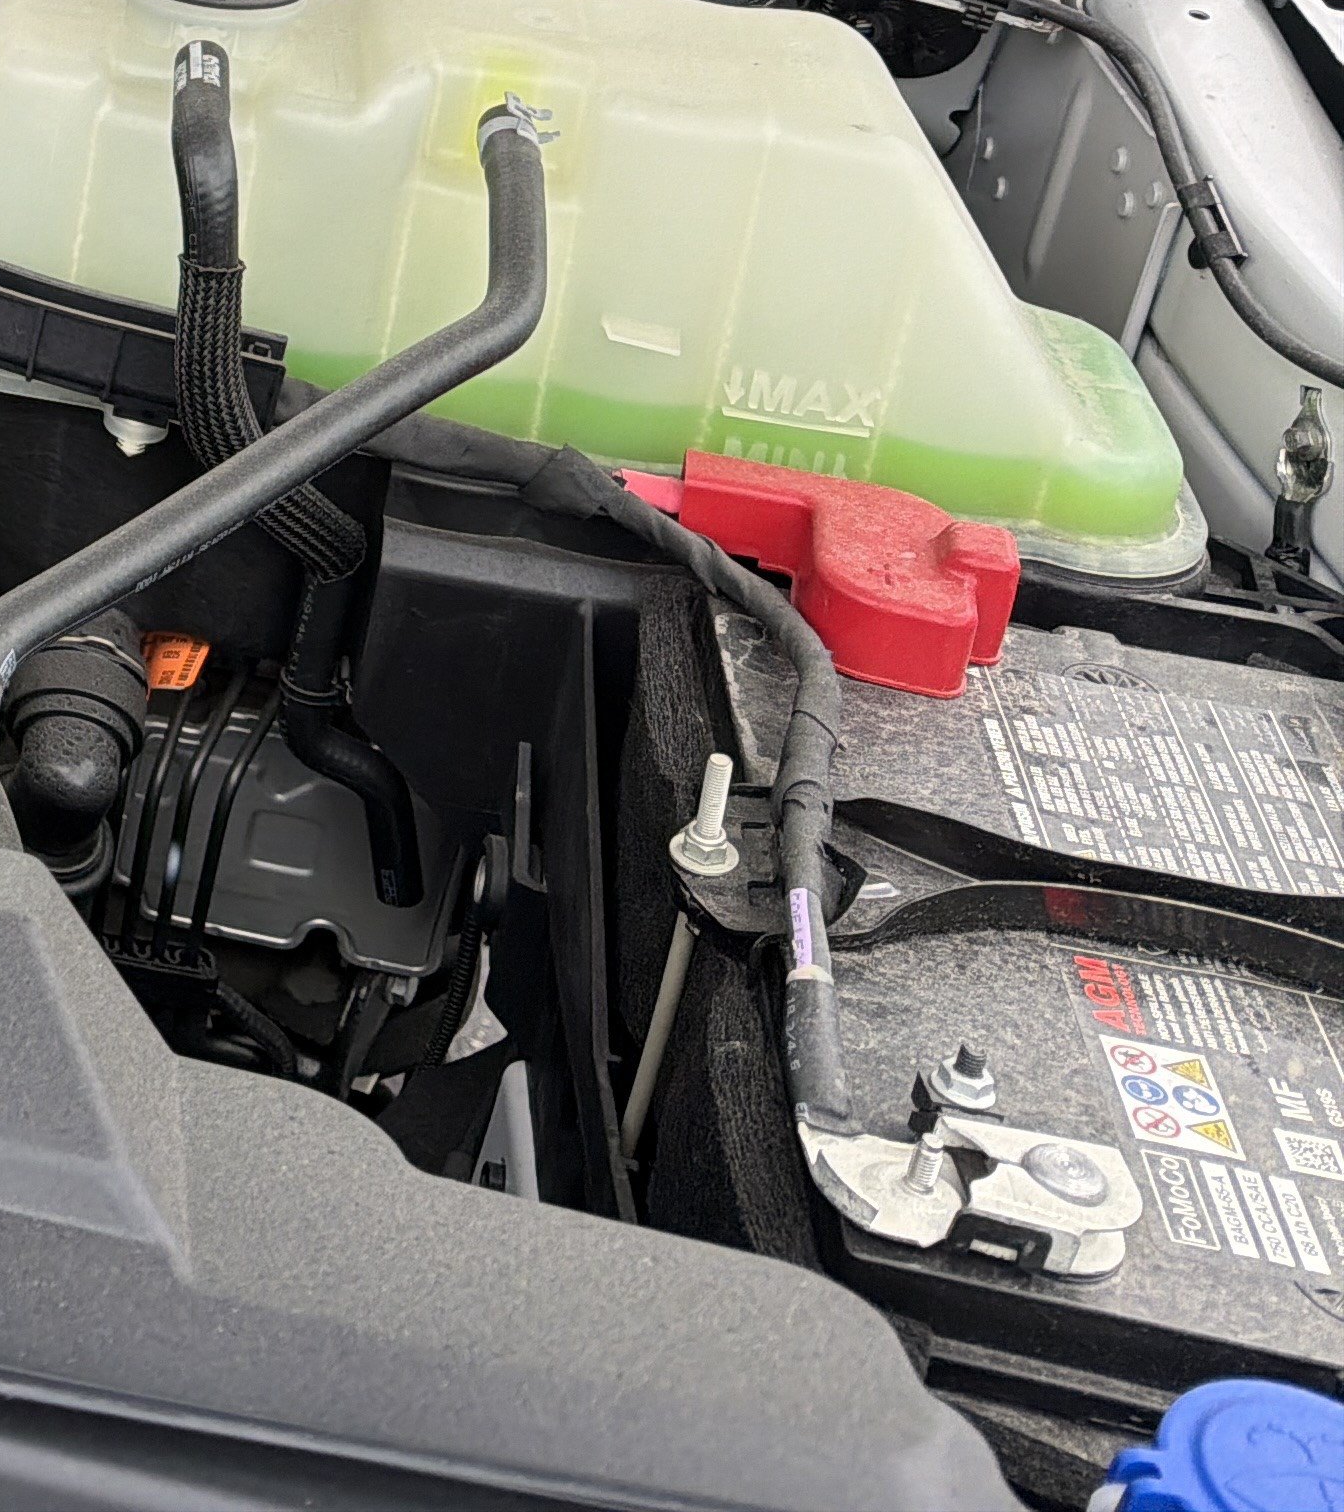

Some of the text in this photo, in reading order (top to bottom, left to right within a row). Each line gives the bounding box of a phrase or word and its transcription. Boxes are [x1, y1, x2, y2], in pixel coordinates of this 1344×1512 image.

[748, 369, 881, 428] MAX
[1074, 955, 1132, 1033] AGM
[1113, 963, 1146, 1036] TECHNOLOGY
[1269, 1077, 1314, 1122] MF
[1160, 1156, 1203, 1243] FoMoCo
[1244, 1176, 1276, 1234] CCA/SAE
[1281, 1191, 1303, 1218] C20
[1291, 1219, 1310, 1237] Ah
